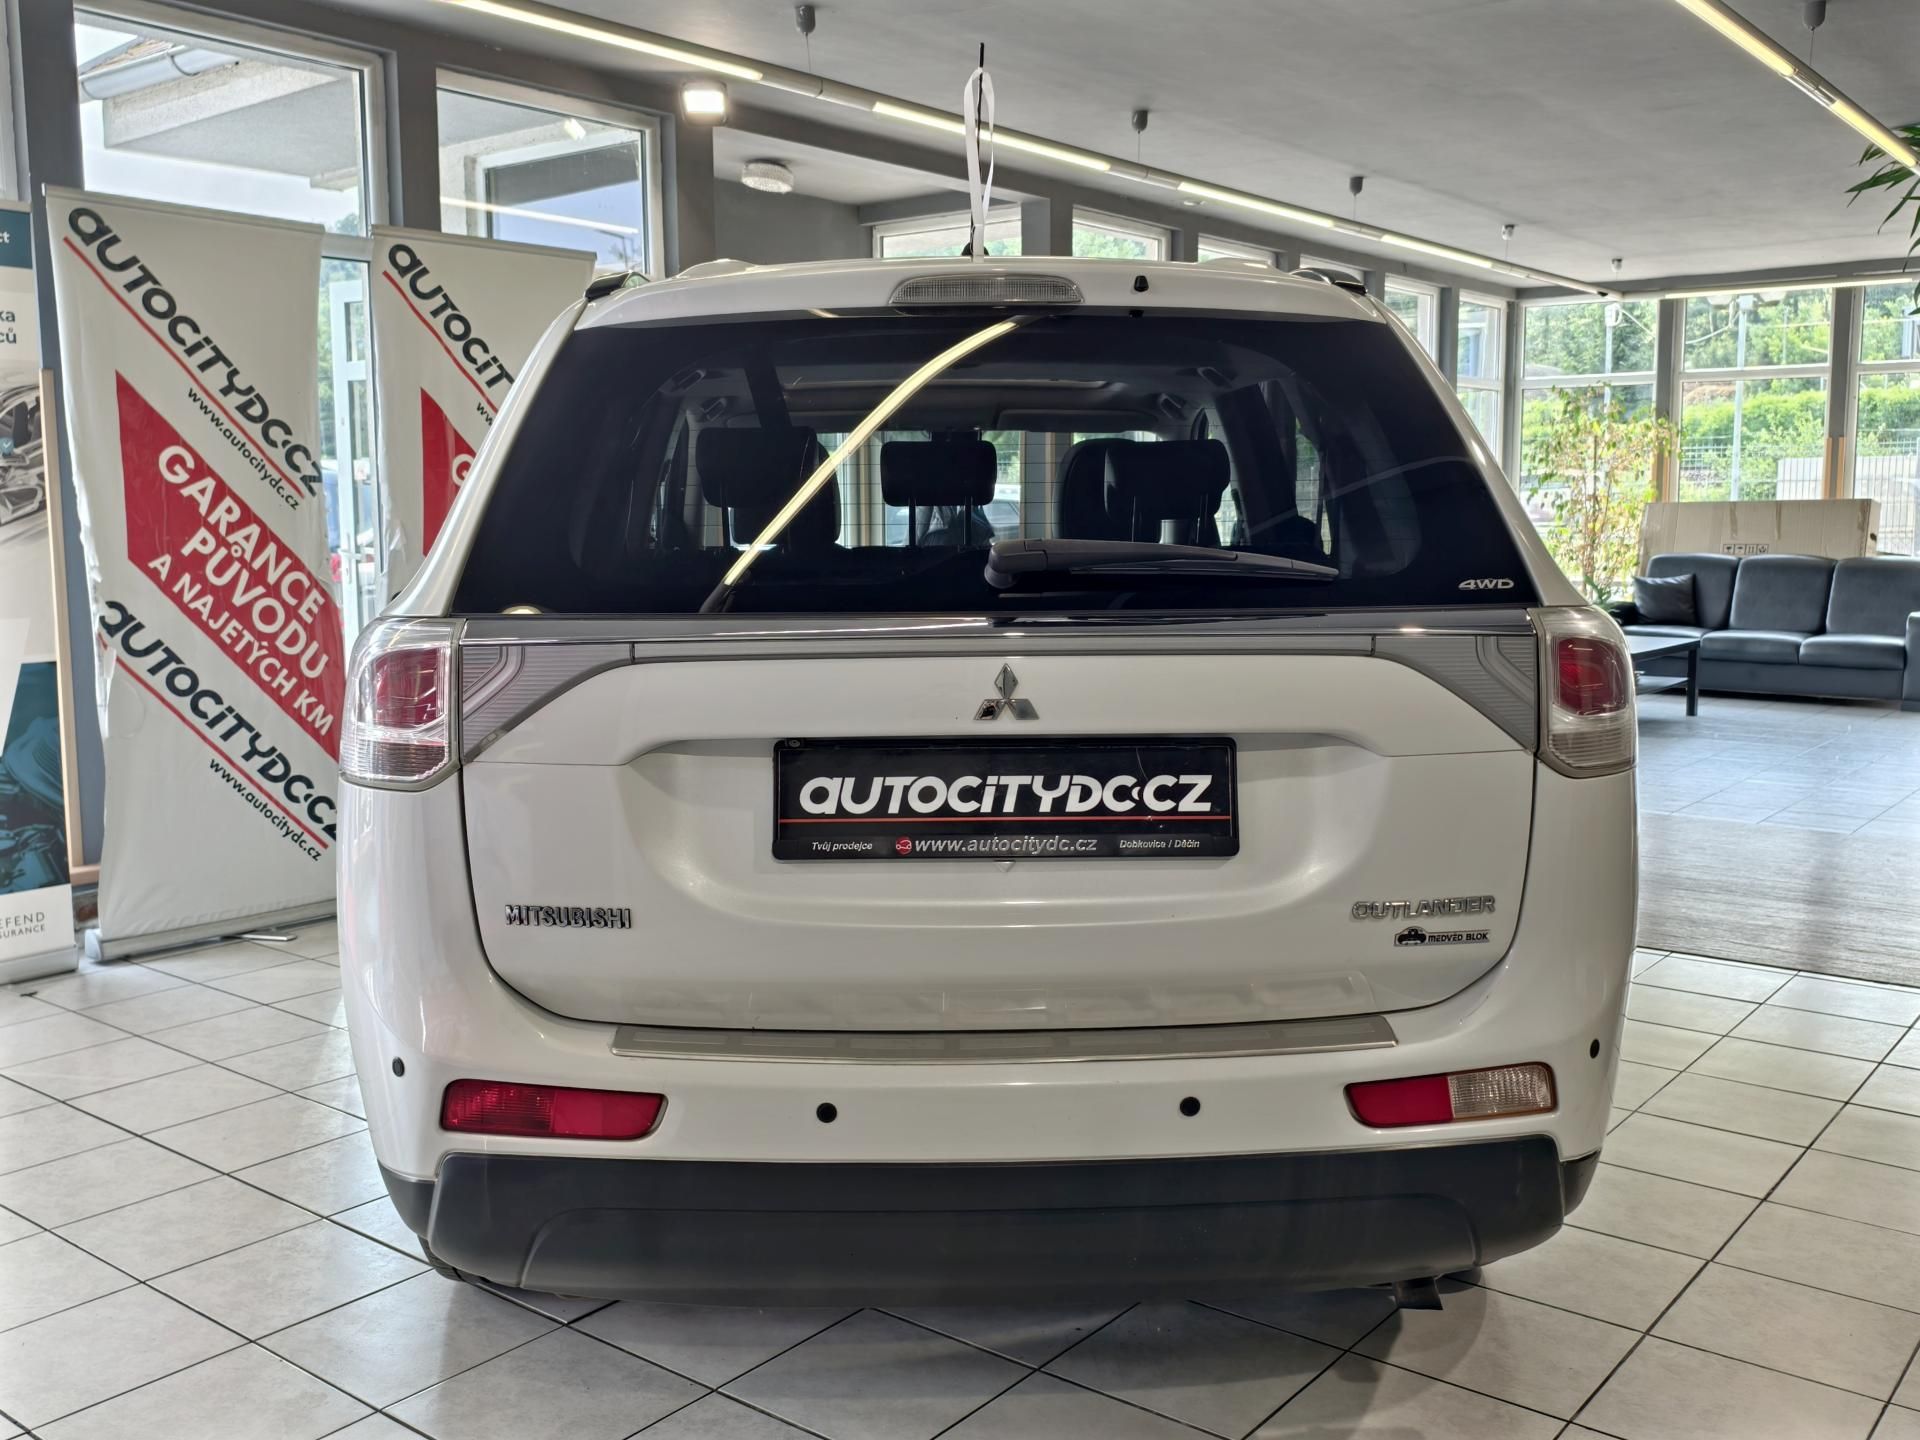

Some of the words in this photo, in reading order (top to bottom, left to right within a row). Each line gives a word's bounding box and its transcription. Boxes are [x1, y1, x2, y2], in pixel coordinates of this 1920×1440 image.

[187, 387, 300, 511] www.autocitydc.cz
[158, 445, 326, 624] GARANCE
[1458, 578, 1514, 590] 4WD
[181, 527, 329, 679] PŮVODU
[148, 554, 173, 582] A
[173, 572, 297, 697] NAJETÝCH
[293, 690, 335, 737] KM
[209, 758, 322, 862] www.autocitydc.cz
[832, 841, 873, 852] prodejce
[914, 835, 1098, 855] www.autocitydc.cz
[505, 904, 632, 929] MITSUBISHI
[1351, 895, 1496, 921] OUTLANDER
[1465, 932, 1489, 941] BLOK
